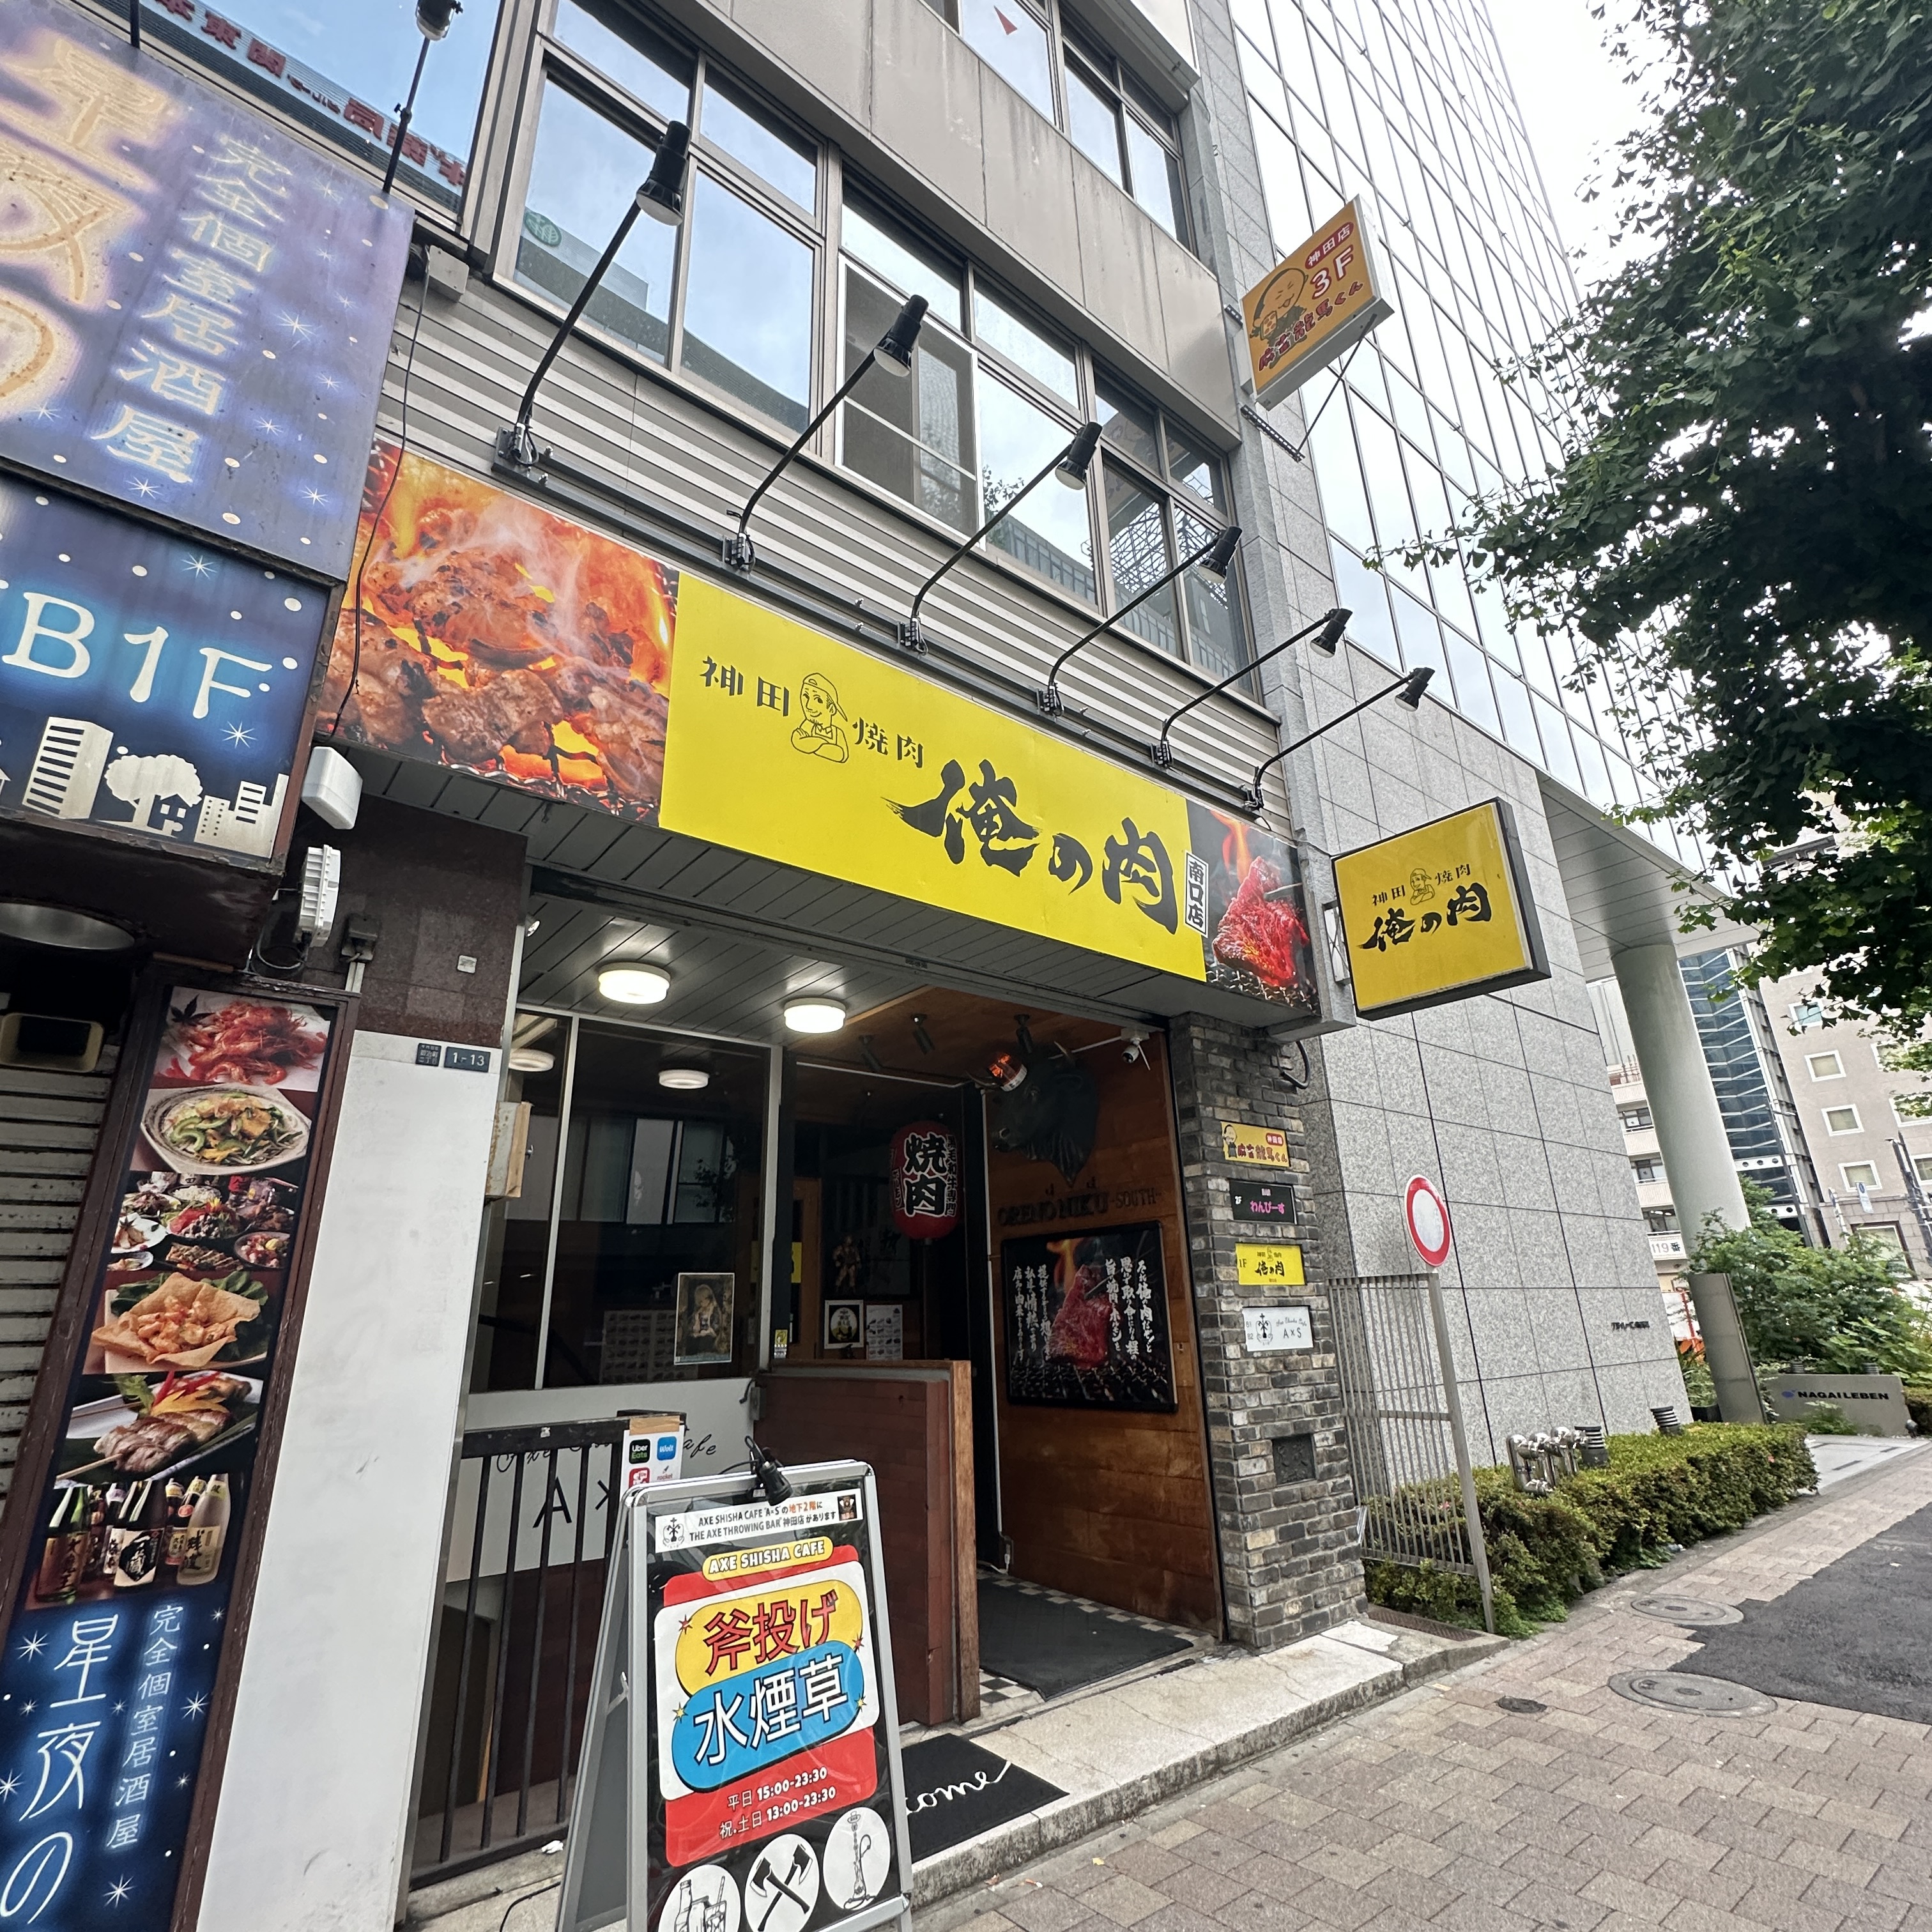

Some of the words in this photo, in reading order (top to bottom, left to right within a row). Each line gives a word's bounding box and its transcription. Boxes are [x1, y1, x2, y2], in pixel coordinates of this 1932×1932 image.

[1307, 224, 1351, 267] 神田店
[1311, 245, 1353, 300] 3F
[91, 133, 293, 483] 完全個室居酒屋
[1, 592, 273, 719] B1F
[700, 655, 790, 717] 神田
[852, 717, 924, 769] 焼肉
[880, 758, 1179, 935] 俺の肉
[1187, 859, 1204, 928] 南口店
[1372, 885, 1406, 907] 神田
[1434, 863, 1471, 886] 焼肉
[1356, 882, 1492, 952] 俺の肉
[452, 1052, 485, 1066] 1-13
[902, 1131, 948, 1218] 焼肉
[1254, 1260, 1285, 1277] 俺の肉
[1797, 1391, 1890, 1400] NAGAILEBEN
[631, 1444, 648, 1452] Uber
[690, 1531, 705, 1542] THE
[707, 1529, 723, 1539] AXE
[723, 1522, 765, 1537] THROWING
[698, 1515, 714, 1527] AXE
[715, 1512, 743, 1524] SHISHA
[744, 1510, 763, 1520] CAFE
[709, 1554, 737, 1574] AXE
[740, 1547, 791, 1568] SHISHA
[793, 1539, 825, 1558] CAFE
[703, 1588, 839, 1677] 斧投げ
[107, 1604, 184, 1850] 完全個室居酒屋
[694, 1652, 849, 1765] 水煙草
[0, 1614, 119, 1925] 星夜の
[728, 1790, 753, 1811] 平日
[756, 1766, 828, 1801] 15:00-23:30
[766, 1786, 837, 1821] 13:00-23:30
